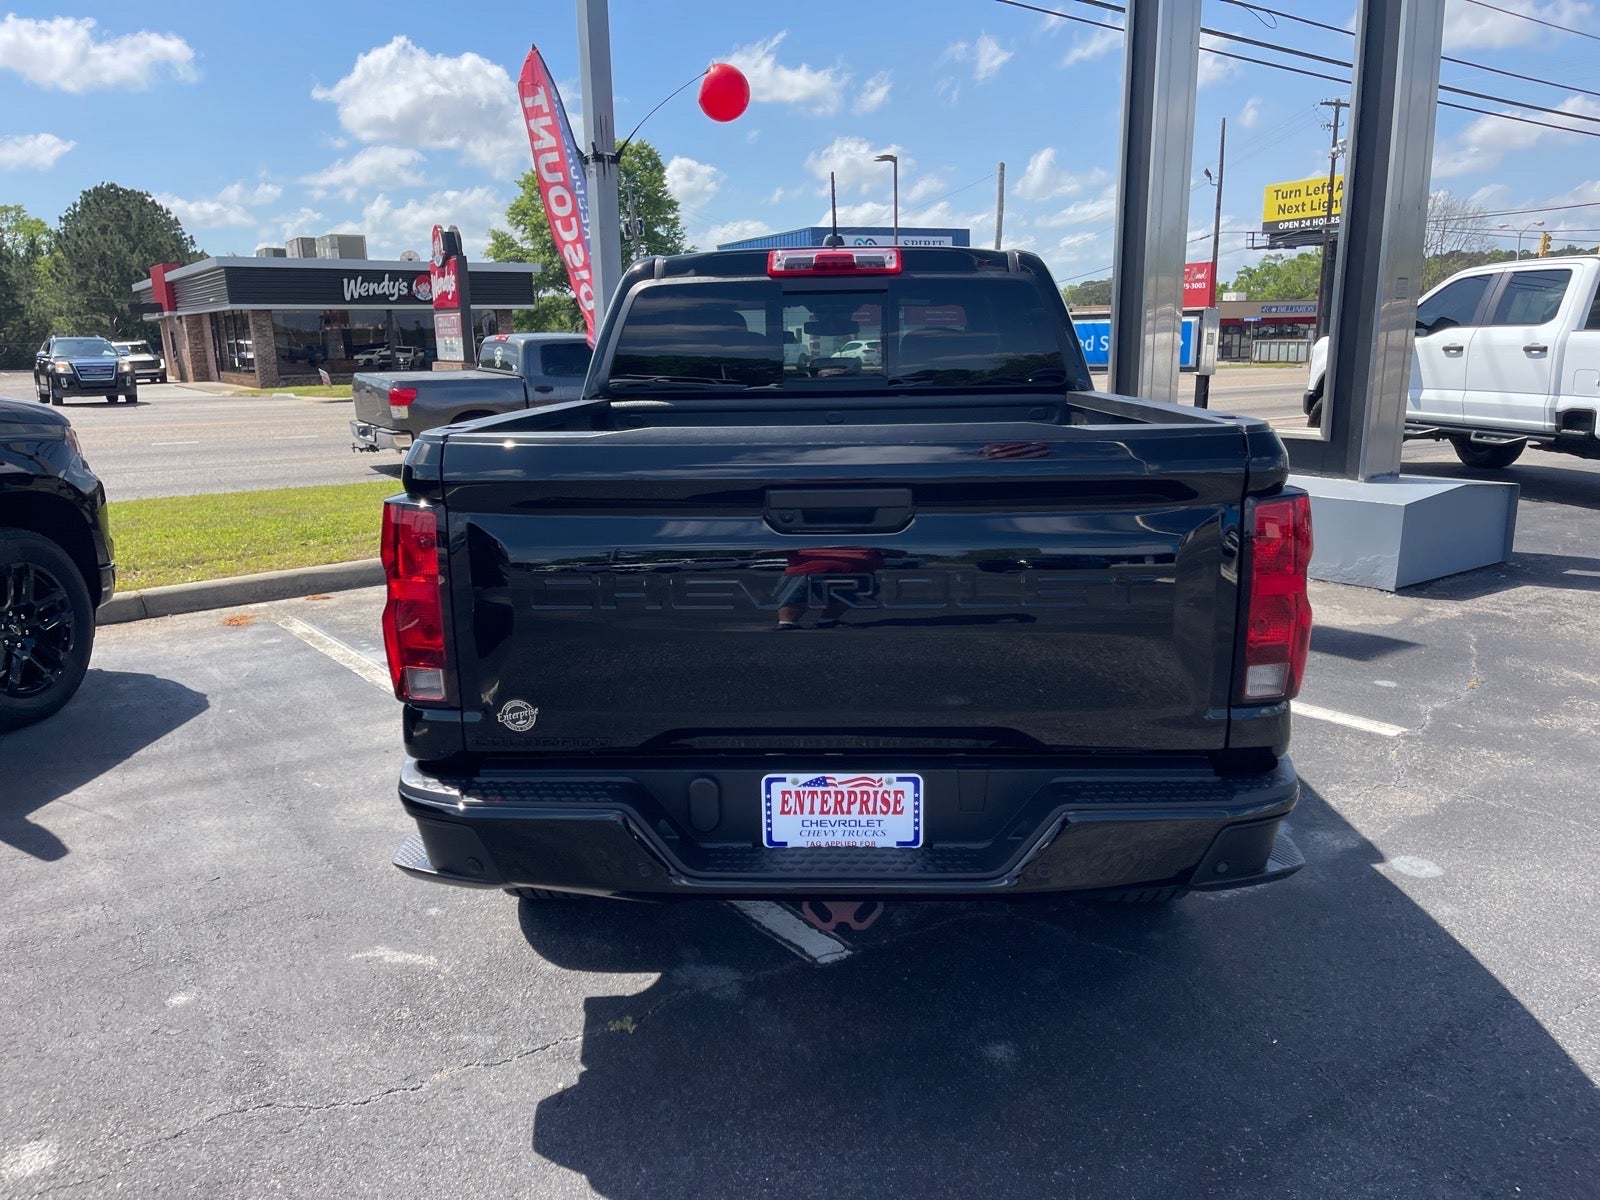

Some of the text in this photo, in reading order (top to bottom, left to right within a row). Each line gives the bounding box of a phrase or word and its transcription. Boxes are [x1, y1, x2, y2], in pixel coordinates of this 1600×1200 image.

[1274, 188, 1301, 200] Turn
[1277, 201, 1306, 215] Next
[1278, 221, 1300, 230] OPEN
[1301, 219, 1311, 228] 24
[342, 273, 409, 301] Wendy's
[431, 266, 456, 301] Wendy's
[531, 573, 1156, 610] CHEVROLET
[496, 707, 539, 723] Enterprise
[779, 789, 905, 816] ENTERPRISE
[801, 819, 885, 828] CHEVROLET
[799, 829, 887, 837] CHEVY TRUCKS
